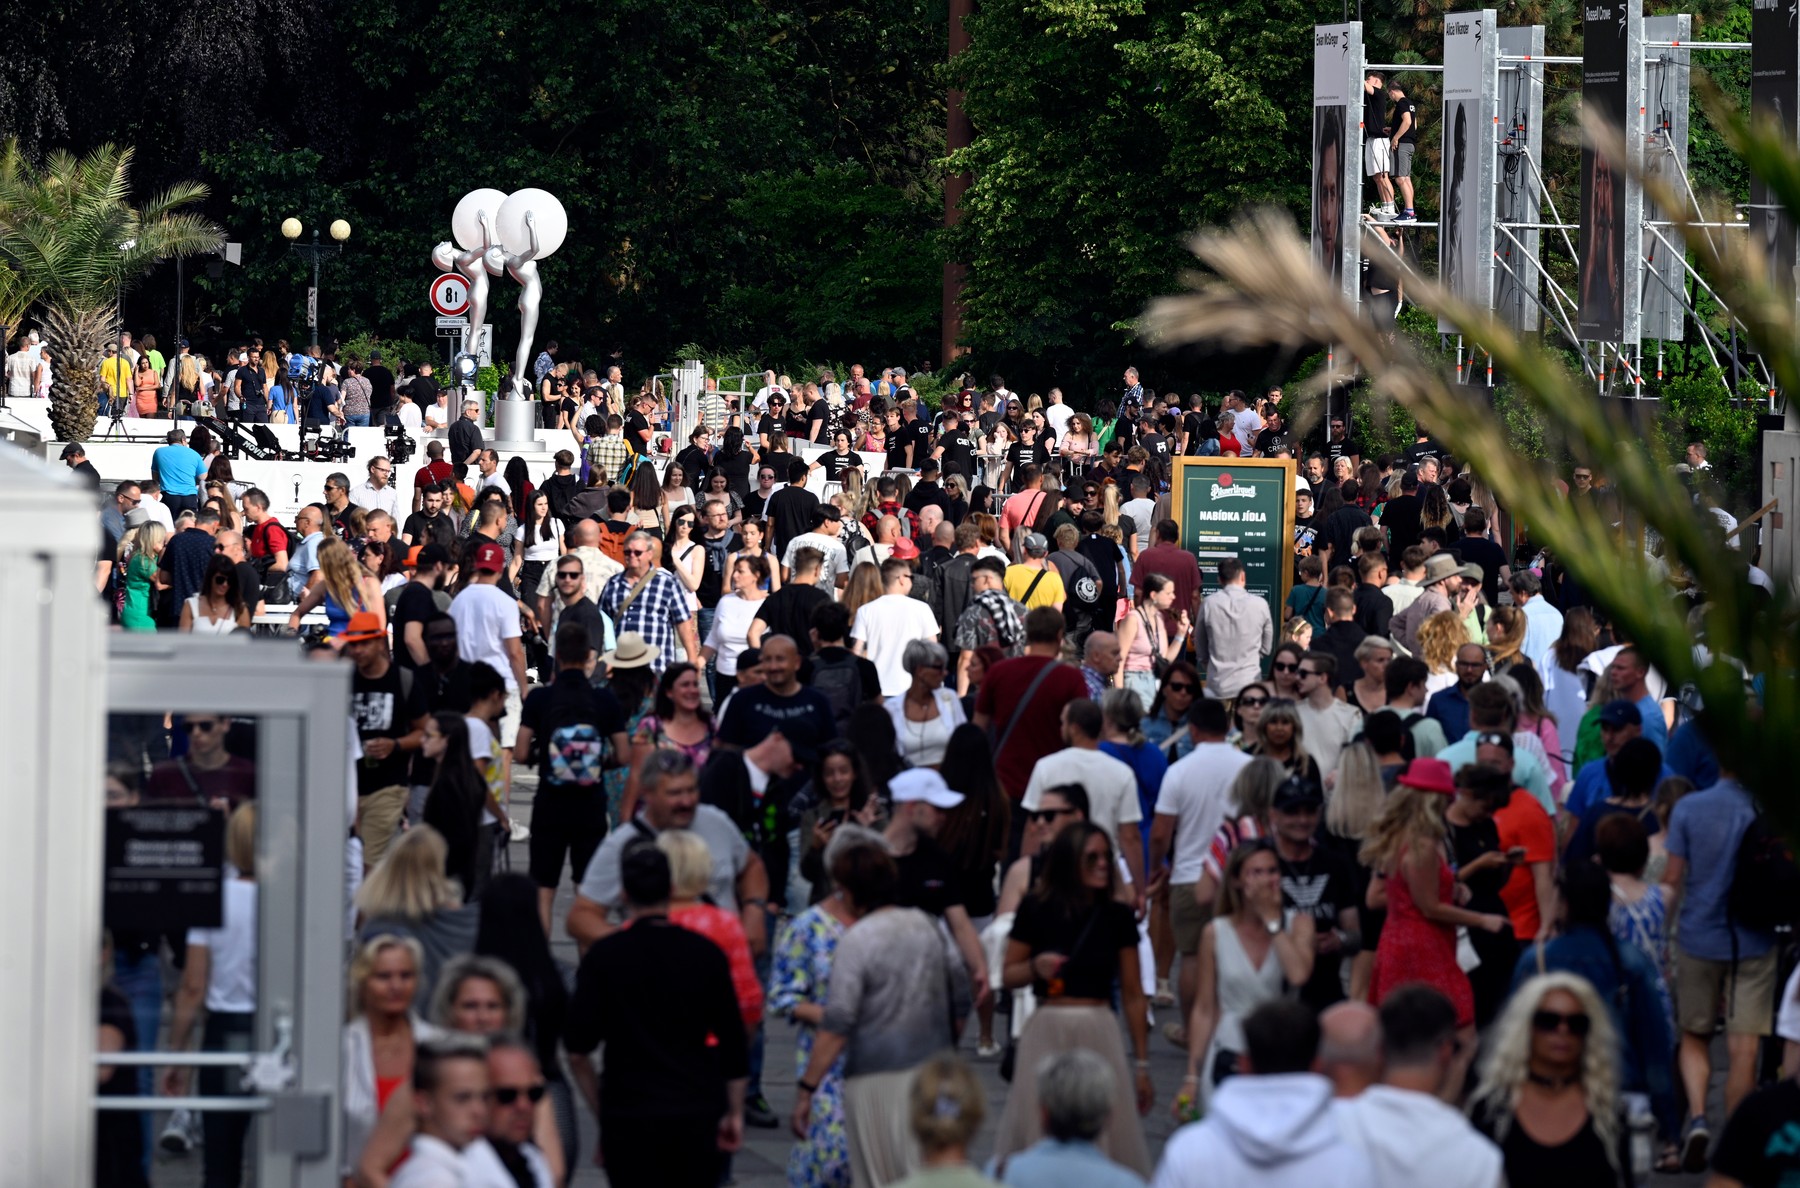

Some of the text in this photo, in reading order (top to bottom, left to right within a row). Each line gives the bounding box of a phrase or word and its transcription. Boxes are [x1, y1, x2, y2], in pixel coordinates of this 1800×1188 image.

[1586, 5, 1611, 21] Russell Crowe
[242, 440, 266, 458] MOVIE
[1199, 509, 1267, 522] NABÍDKA JÍDLA
[485, 549, 495, 561] F
